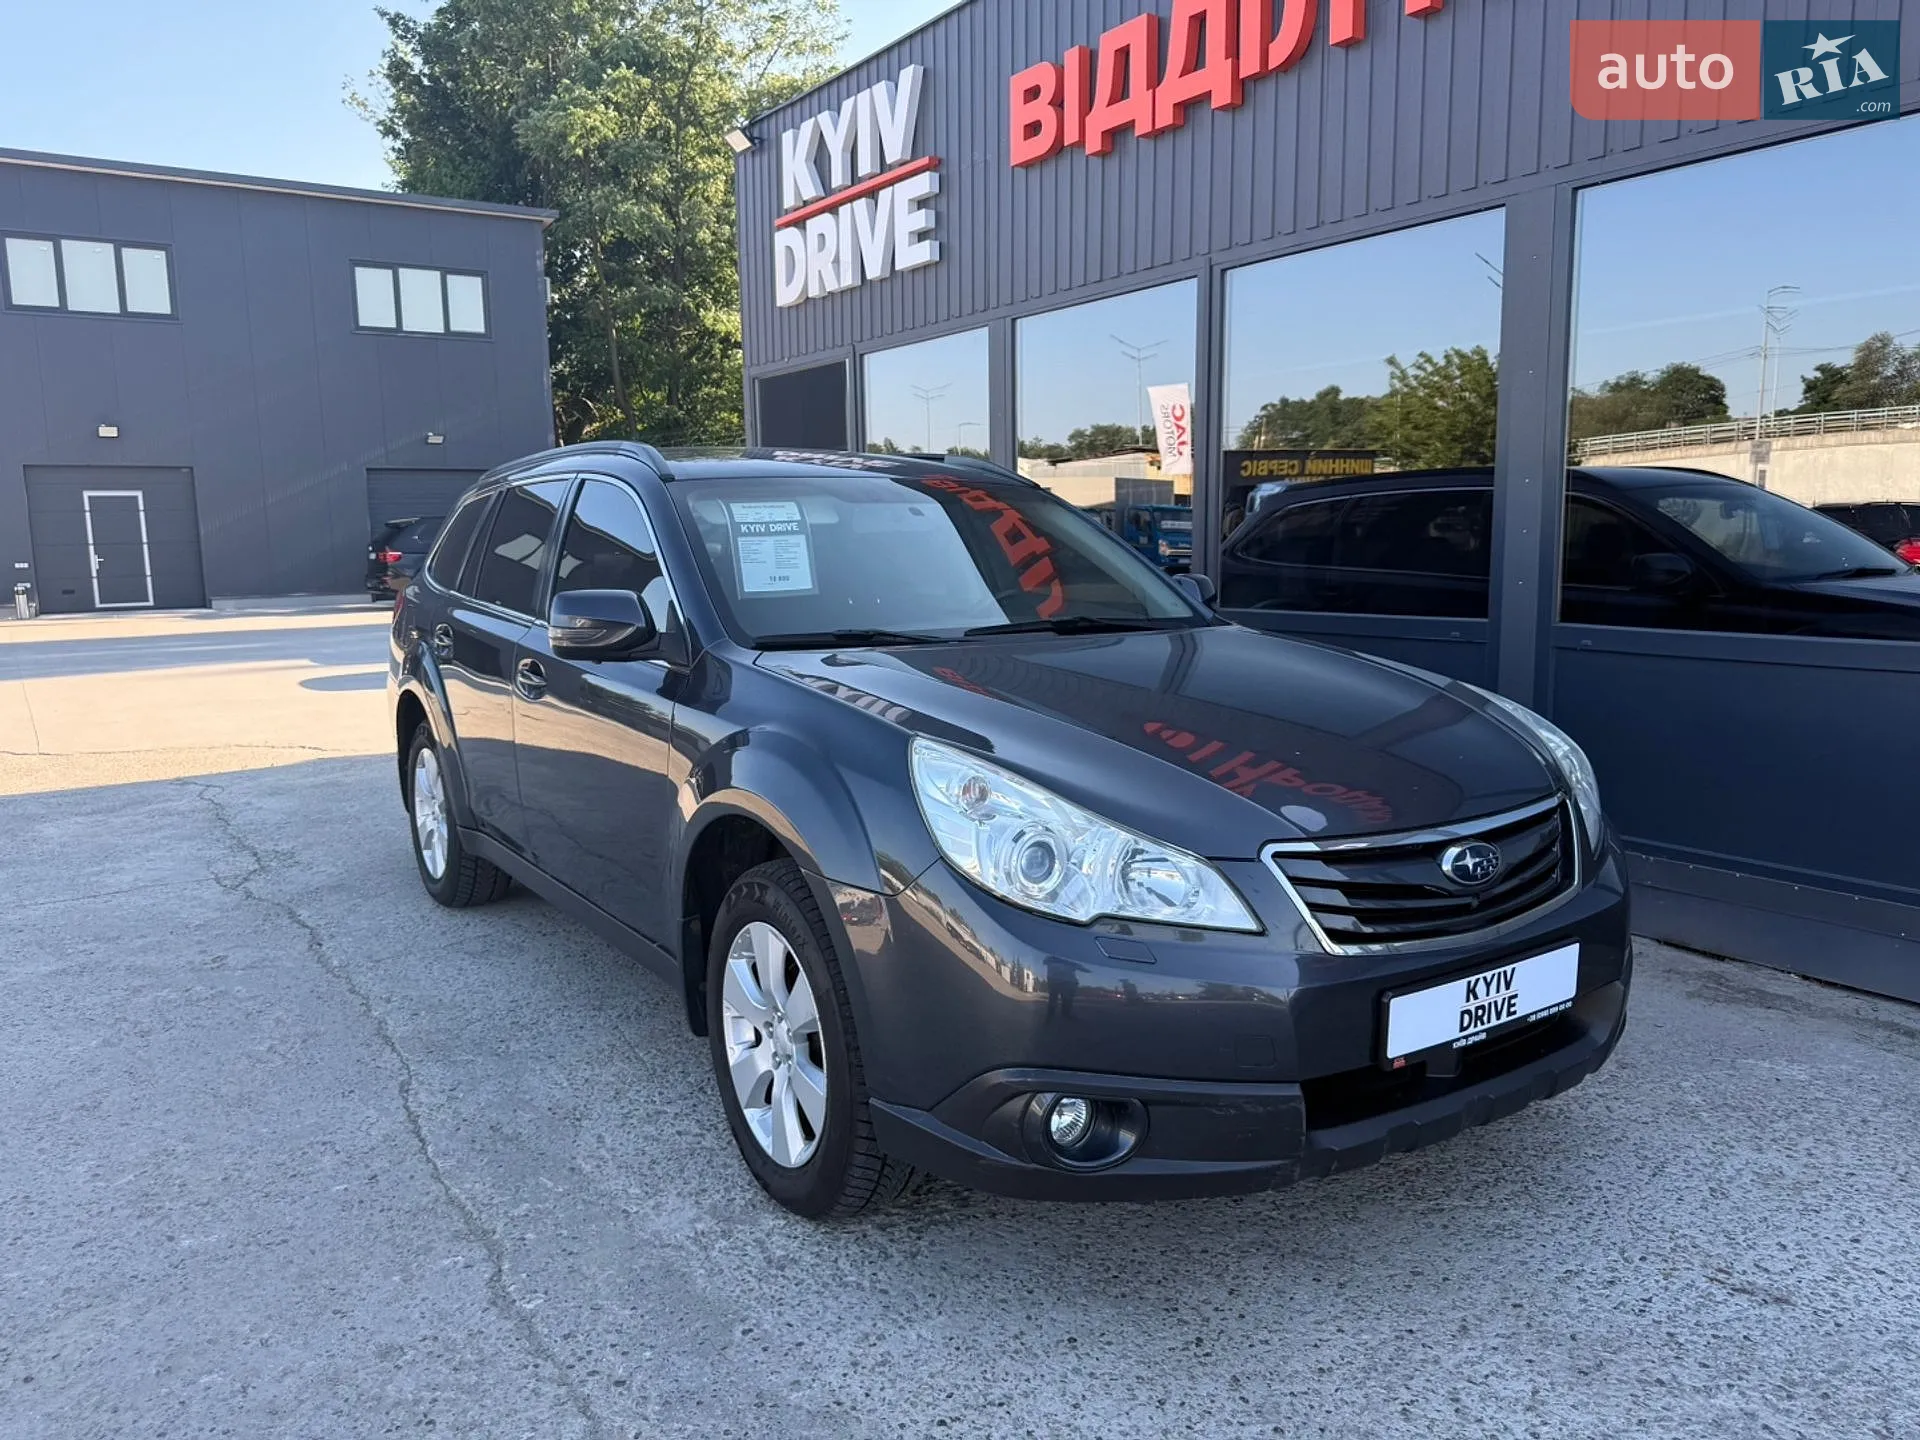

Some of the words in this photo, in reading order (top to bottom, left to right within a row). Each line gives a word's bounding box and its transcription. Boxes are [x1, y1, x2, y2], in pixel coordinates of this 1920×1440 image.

[782, 64, 924, 209] KYIV
[775, 171, 940, 307] DRIVE
[741, 524, 766, 533] KYIV
[769, 522, 799, 532] DRIVE
[1466, 967, 1516, 1003] KYIV
[1459, 993, 1519, 1033] DRIVE
